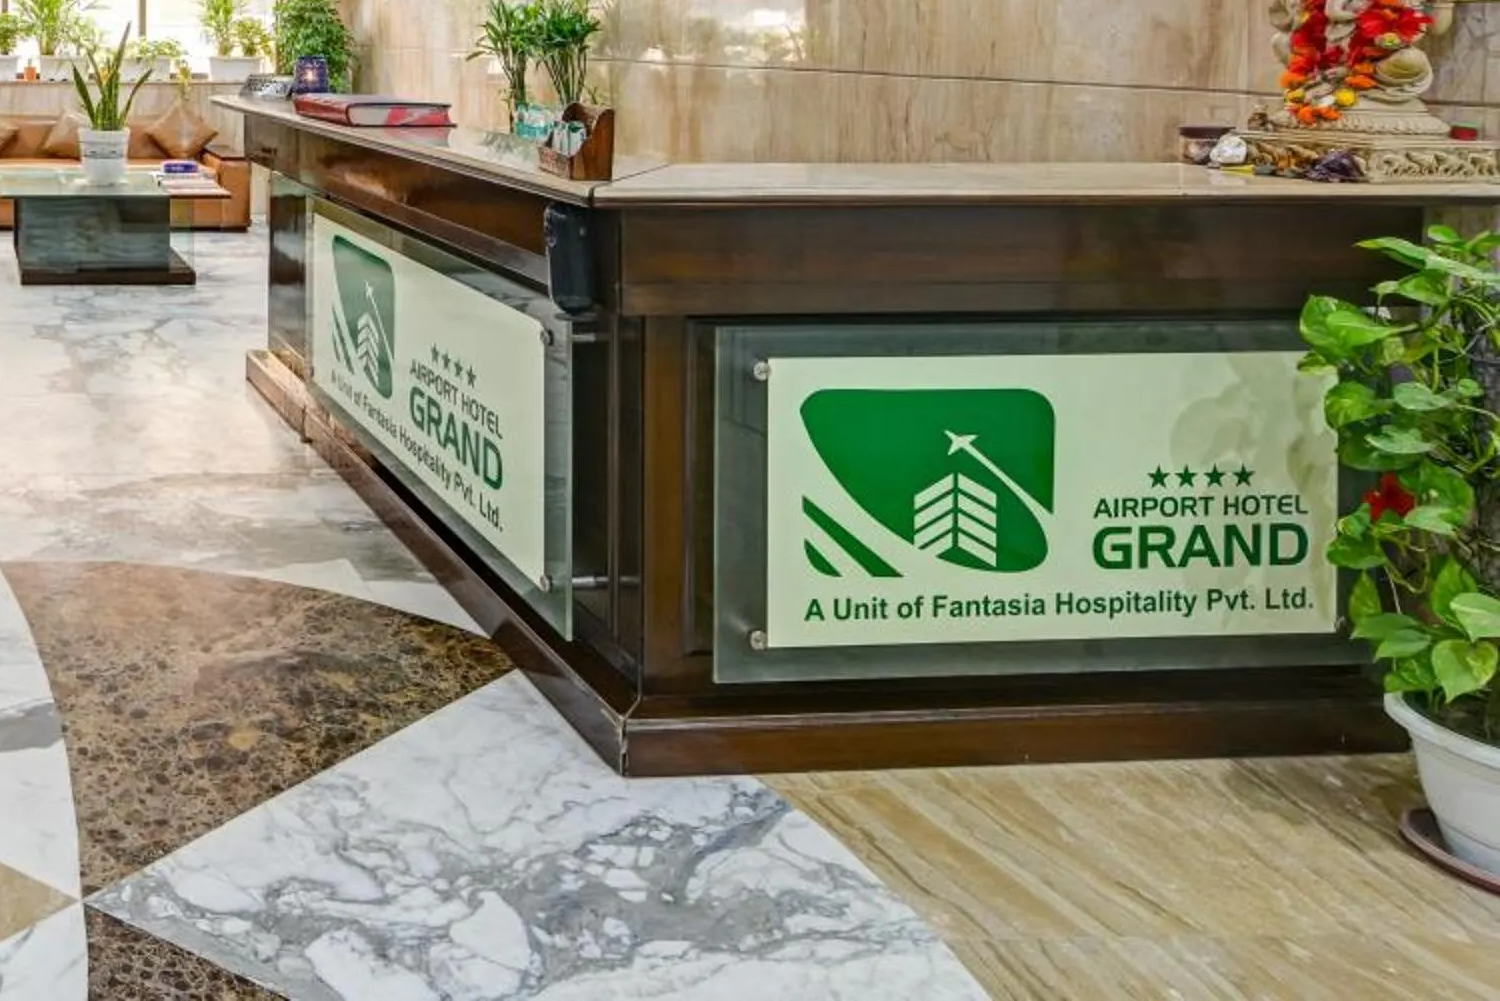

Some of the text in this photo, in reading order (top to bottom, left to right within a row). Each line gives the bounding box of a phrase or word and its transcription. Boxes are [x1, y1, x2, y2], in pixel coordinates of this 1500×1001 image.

[410, 359, 503, 440] AIRPORT HOTEL
[363, 396, 398, 440] Fantasia
[399, 425, 451, 490] Hospitality
[454, 472, 476, 507] Pvt.
[479, 492, 504, 533] Ltd.
[410, 386, 503, 490] GRAND
[1093, 494, 1309, 519] AIRPORT HOTEL
[1092, 522, 1309, 570] GRAND
[803, 587, 1314, 622] A Unit of Fantasia Hospitality Pvt. Ltd.
